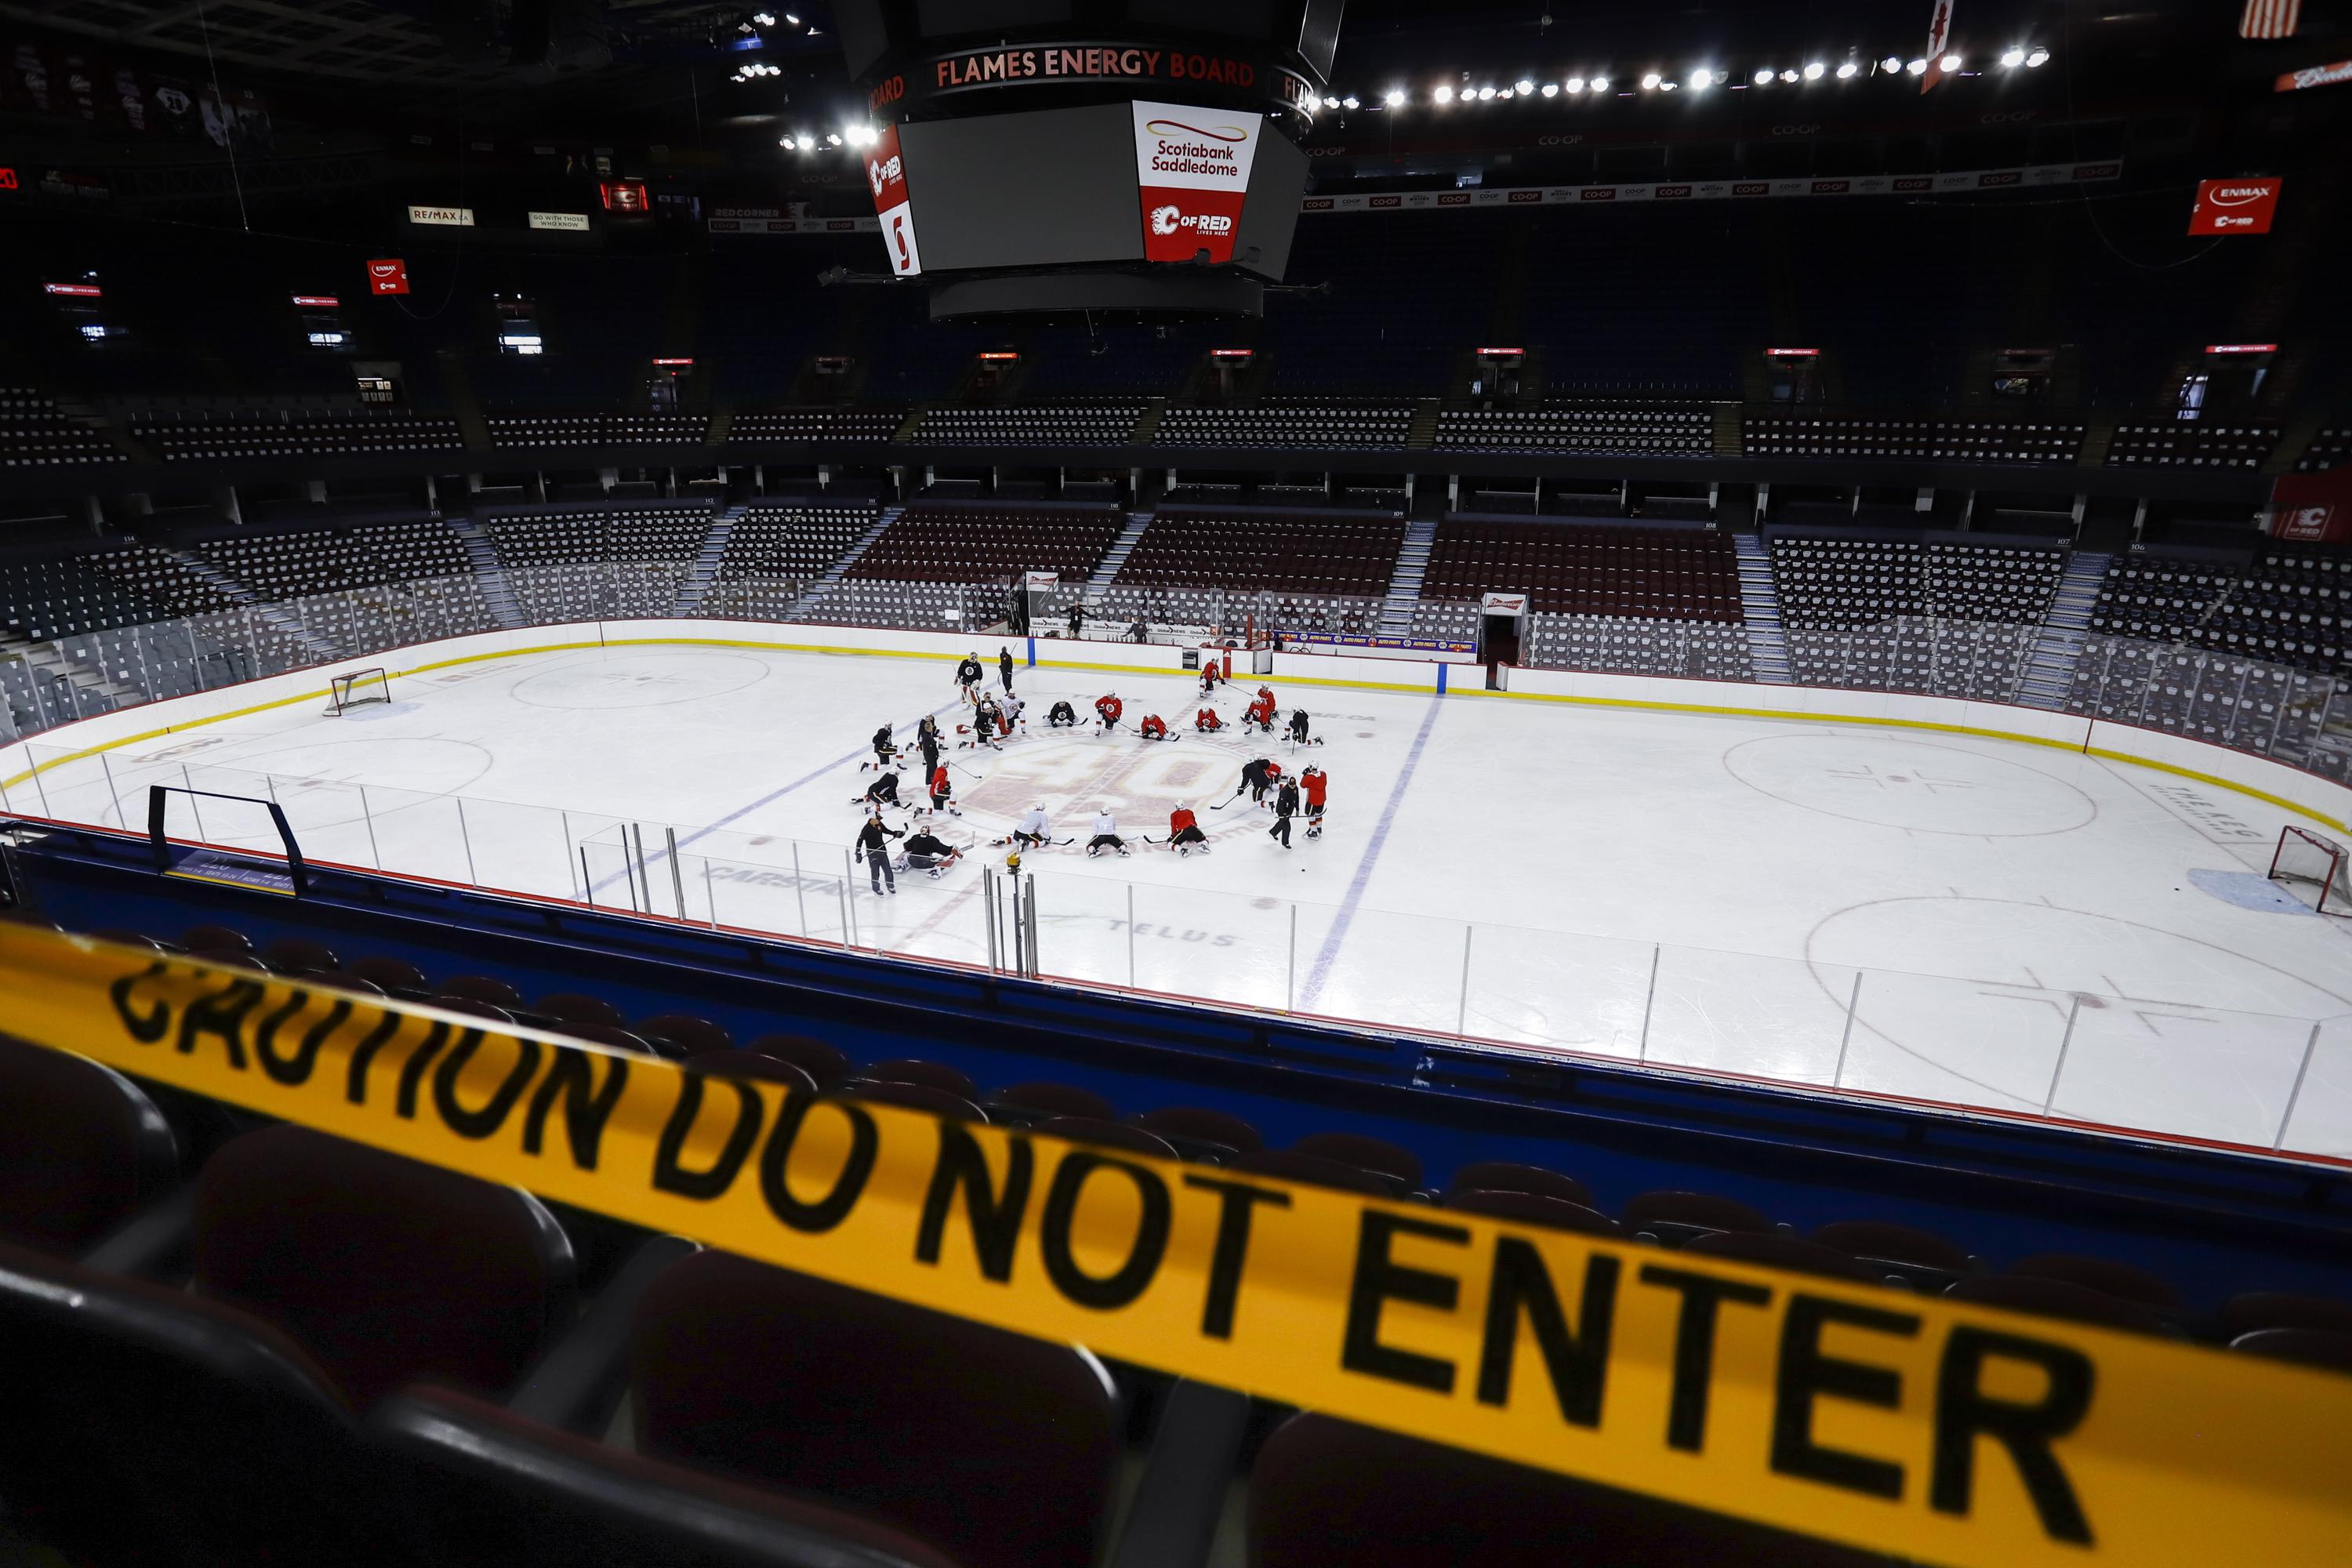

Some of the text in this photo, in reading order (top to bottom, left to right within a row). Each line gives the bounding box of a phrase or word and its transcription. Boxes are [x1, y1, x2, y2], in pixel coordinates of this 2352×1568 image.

[936, 49, 1254, 88] FLAMES ENERGY BOARD
[1158, 140, 1233, 160] Scotiabank
[887, 156, 901, 179] RED
[1152, 157, 1238, 176] Saddledome
[1815, 183, 1845, 191] CO-OP
[1984, 175, 2017, 184] CO-OP
[2220, 187, 2271, 197] ENMAX
[715, 209, 779, 217] RED CORNER
[1180, 215, 1198, 227] OF
[1198, 215, 1232, 231] RED
[2167, 786, 2263, 837] THE KEG
[1109, 920, 1240, 947] TELUS
[110, 961, 2097, 1551] CAUTION DO NOT ENTER
